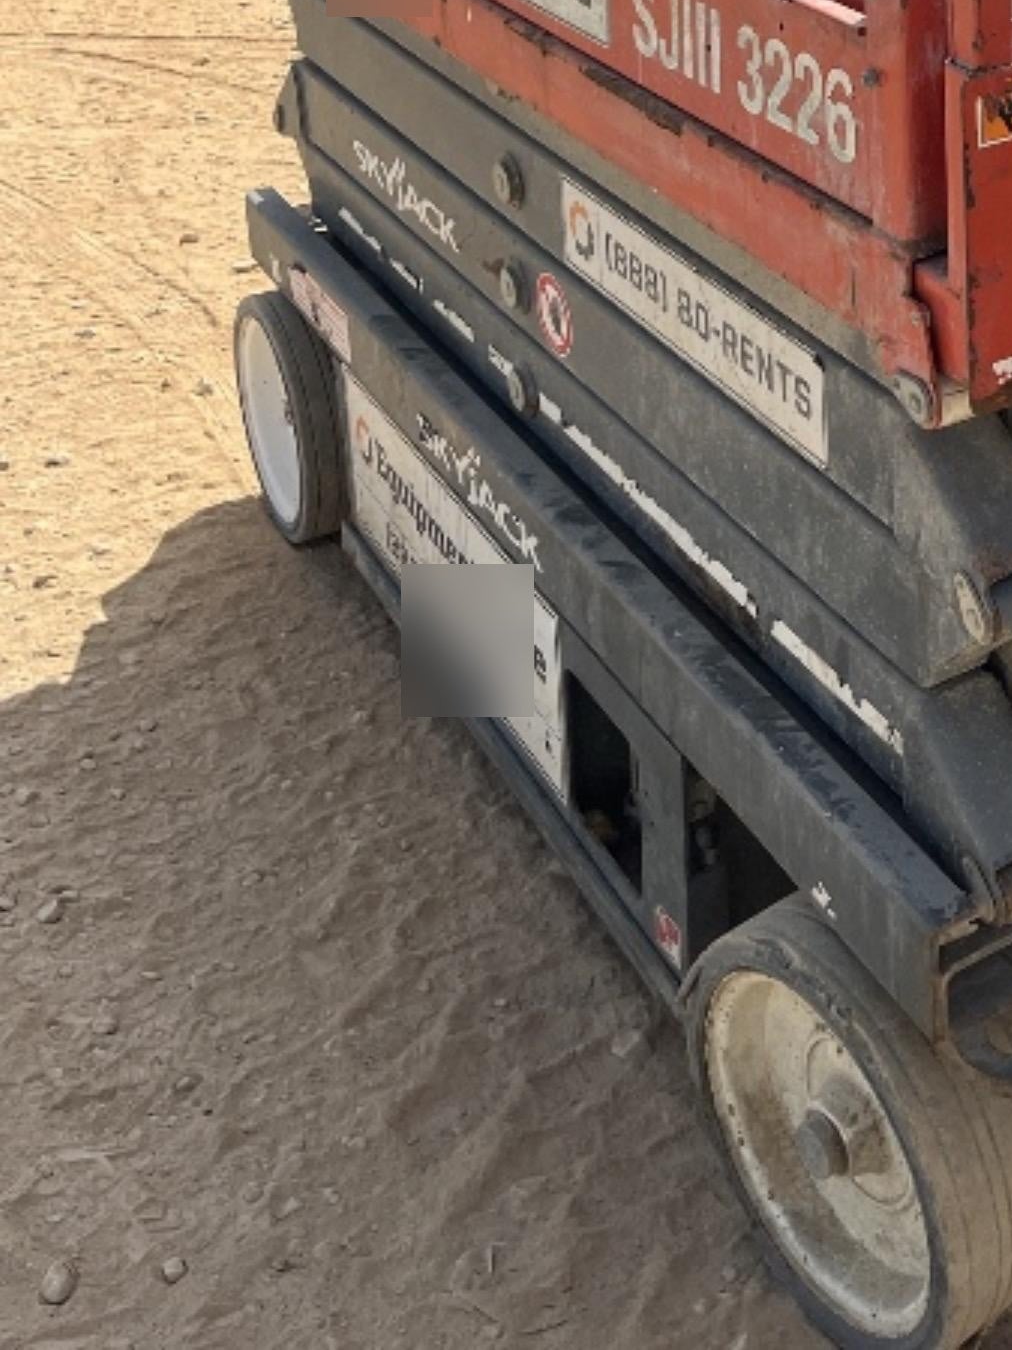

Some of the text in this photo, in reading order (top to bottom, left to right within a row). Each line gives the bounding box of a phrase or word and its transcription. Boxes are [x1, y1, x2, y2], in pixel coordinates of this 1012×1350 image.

[735, 24, 857, 163] 3226
[352, 140, 459, 252] SKYJACK
[605, 232, 668, 313] (888)
[416, 413, 544, 573] SKYJACK
